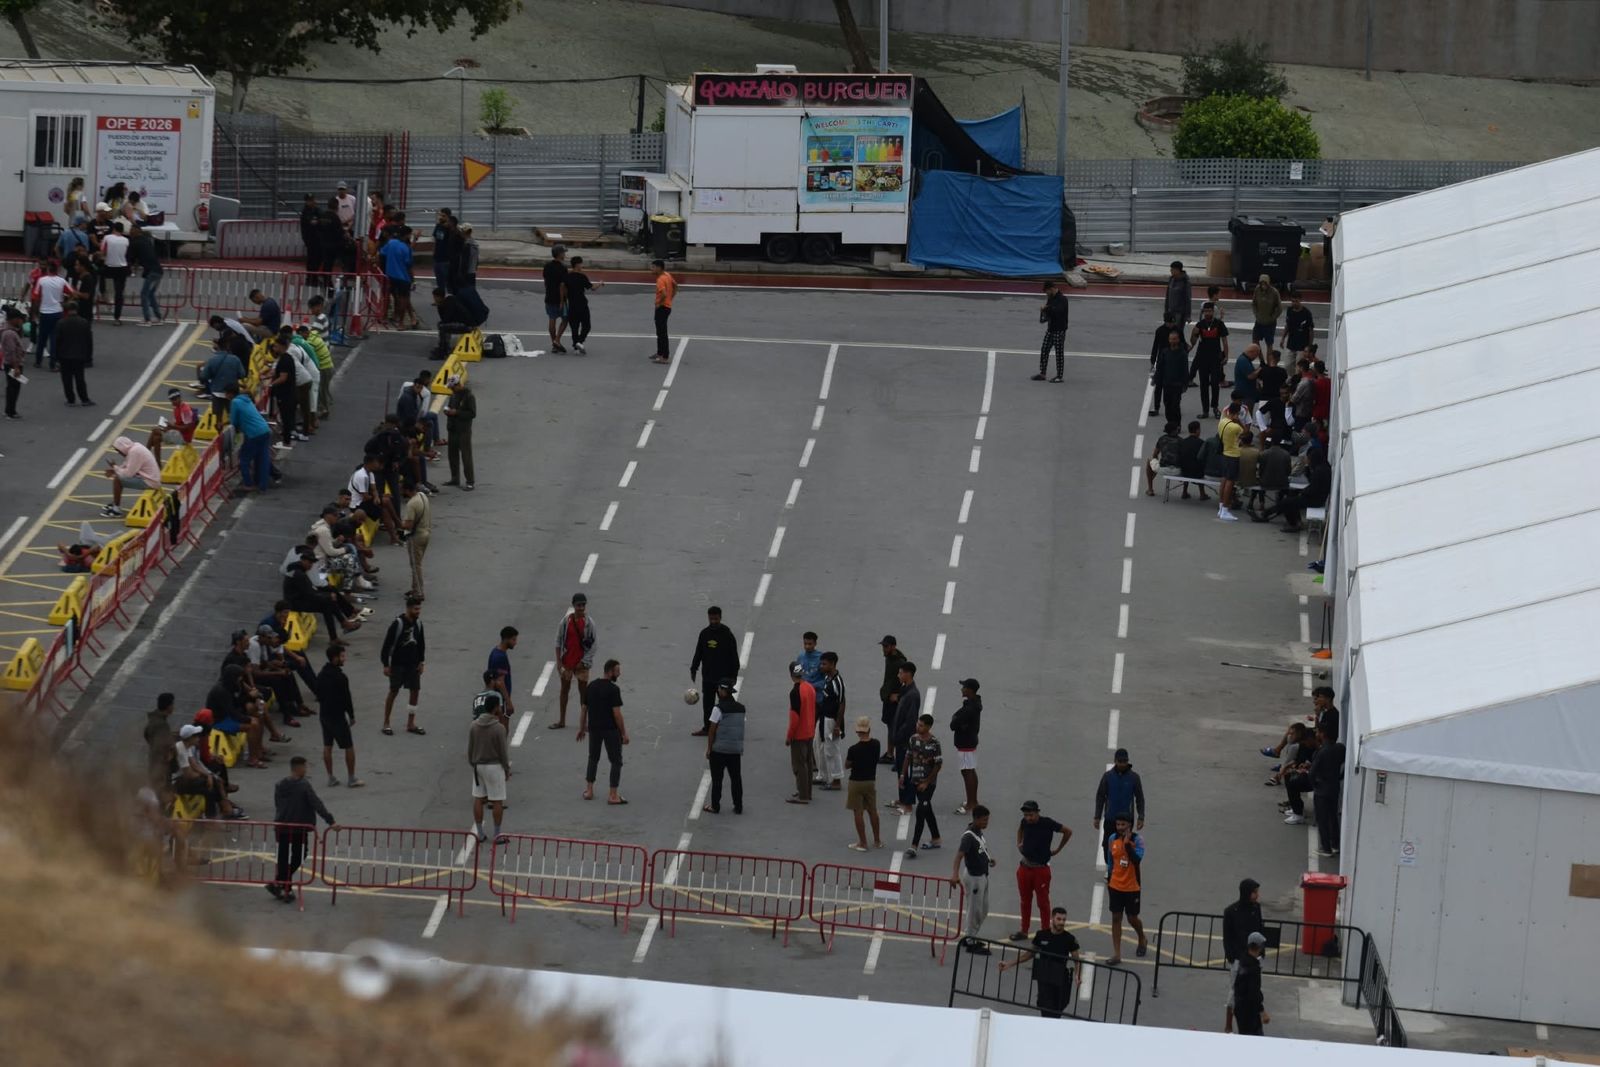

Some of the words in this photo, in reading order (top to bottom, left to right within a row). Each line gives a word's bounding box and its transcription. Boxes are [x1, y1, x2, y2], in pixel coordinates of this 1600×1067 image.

[699, 79, 798, 105] GONZALO
[803, 81, 907, 100] BURGUER
[106, 118, 136, 130] OPE
[140, 120, 173, 130] 2026
